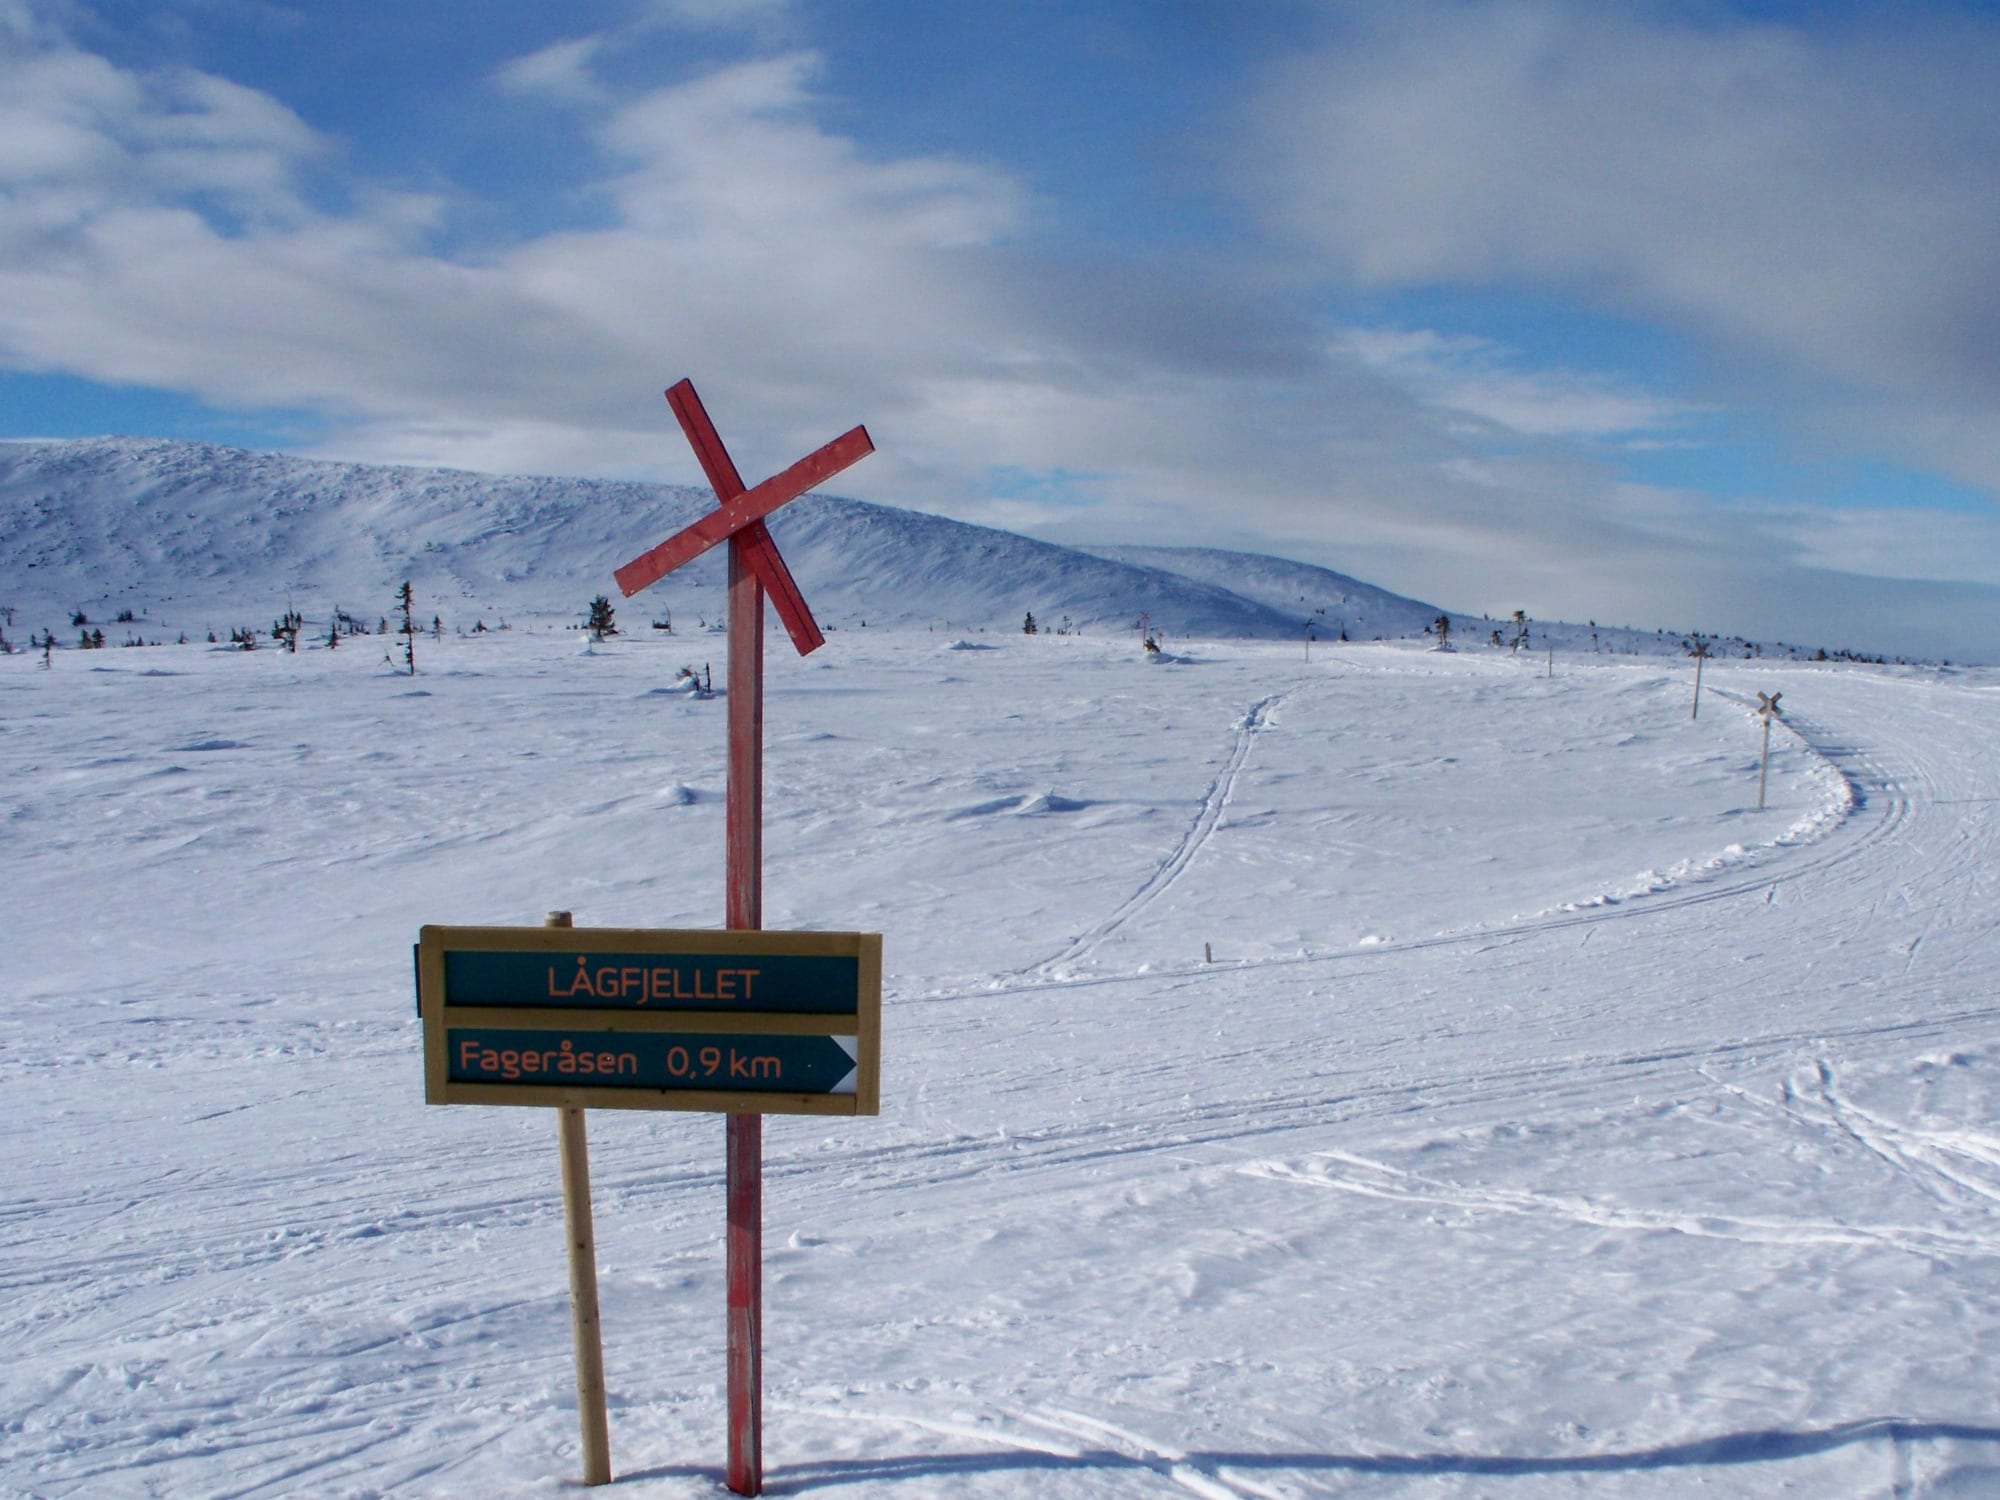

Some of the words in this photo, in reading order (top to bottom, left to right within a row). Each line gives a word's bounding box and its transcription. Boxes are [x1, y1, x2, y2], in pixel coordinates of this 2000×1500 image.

[548, 956, 760, 1005] LÅGFJELLET
[460, 1040, 637, 1079] Fageråsen
[667, 1046, 721, 1080] 0,9
[730, 1048, 781, 1078] km
